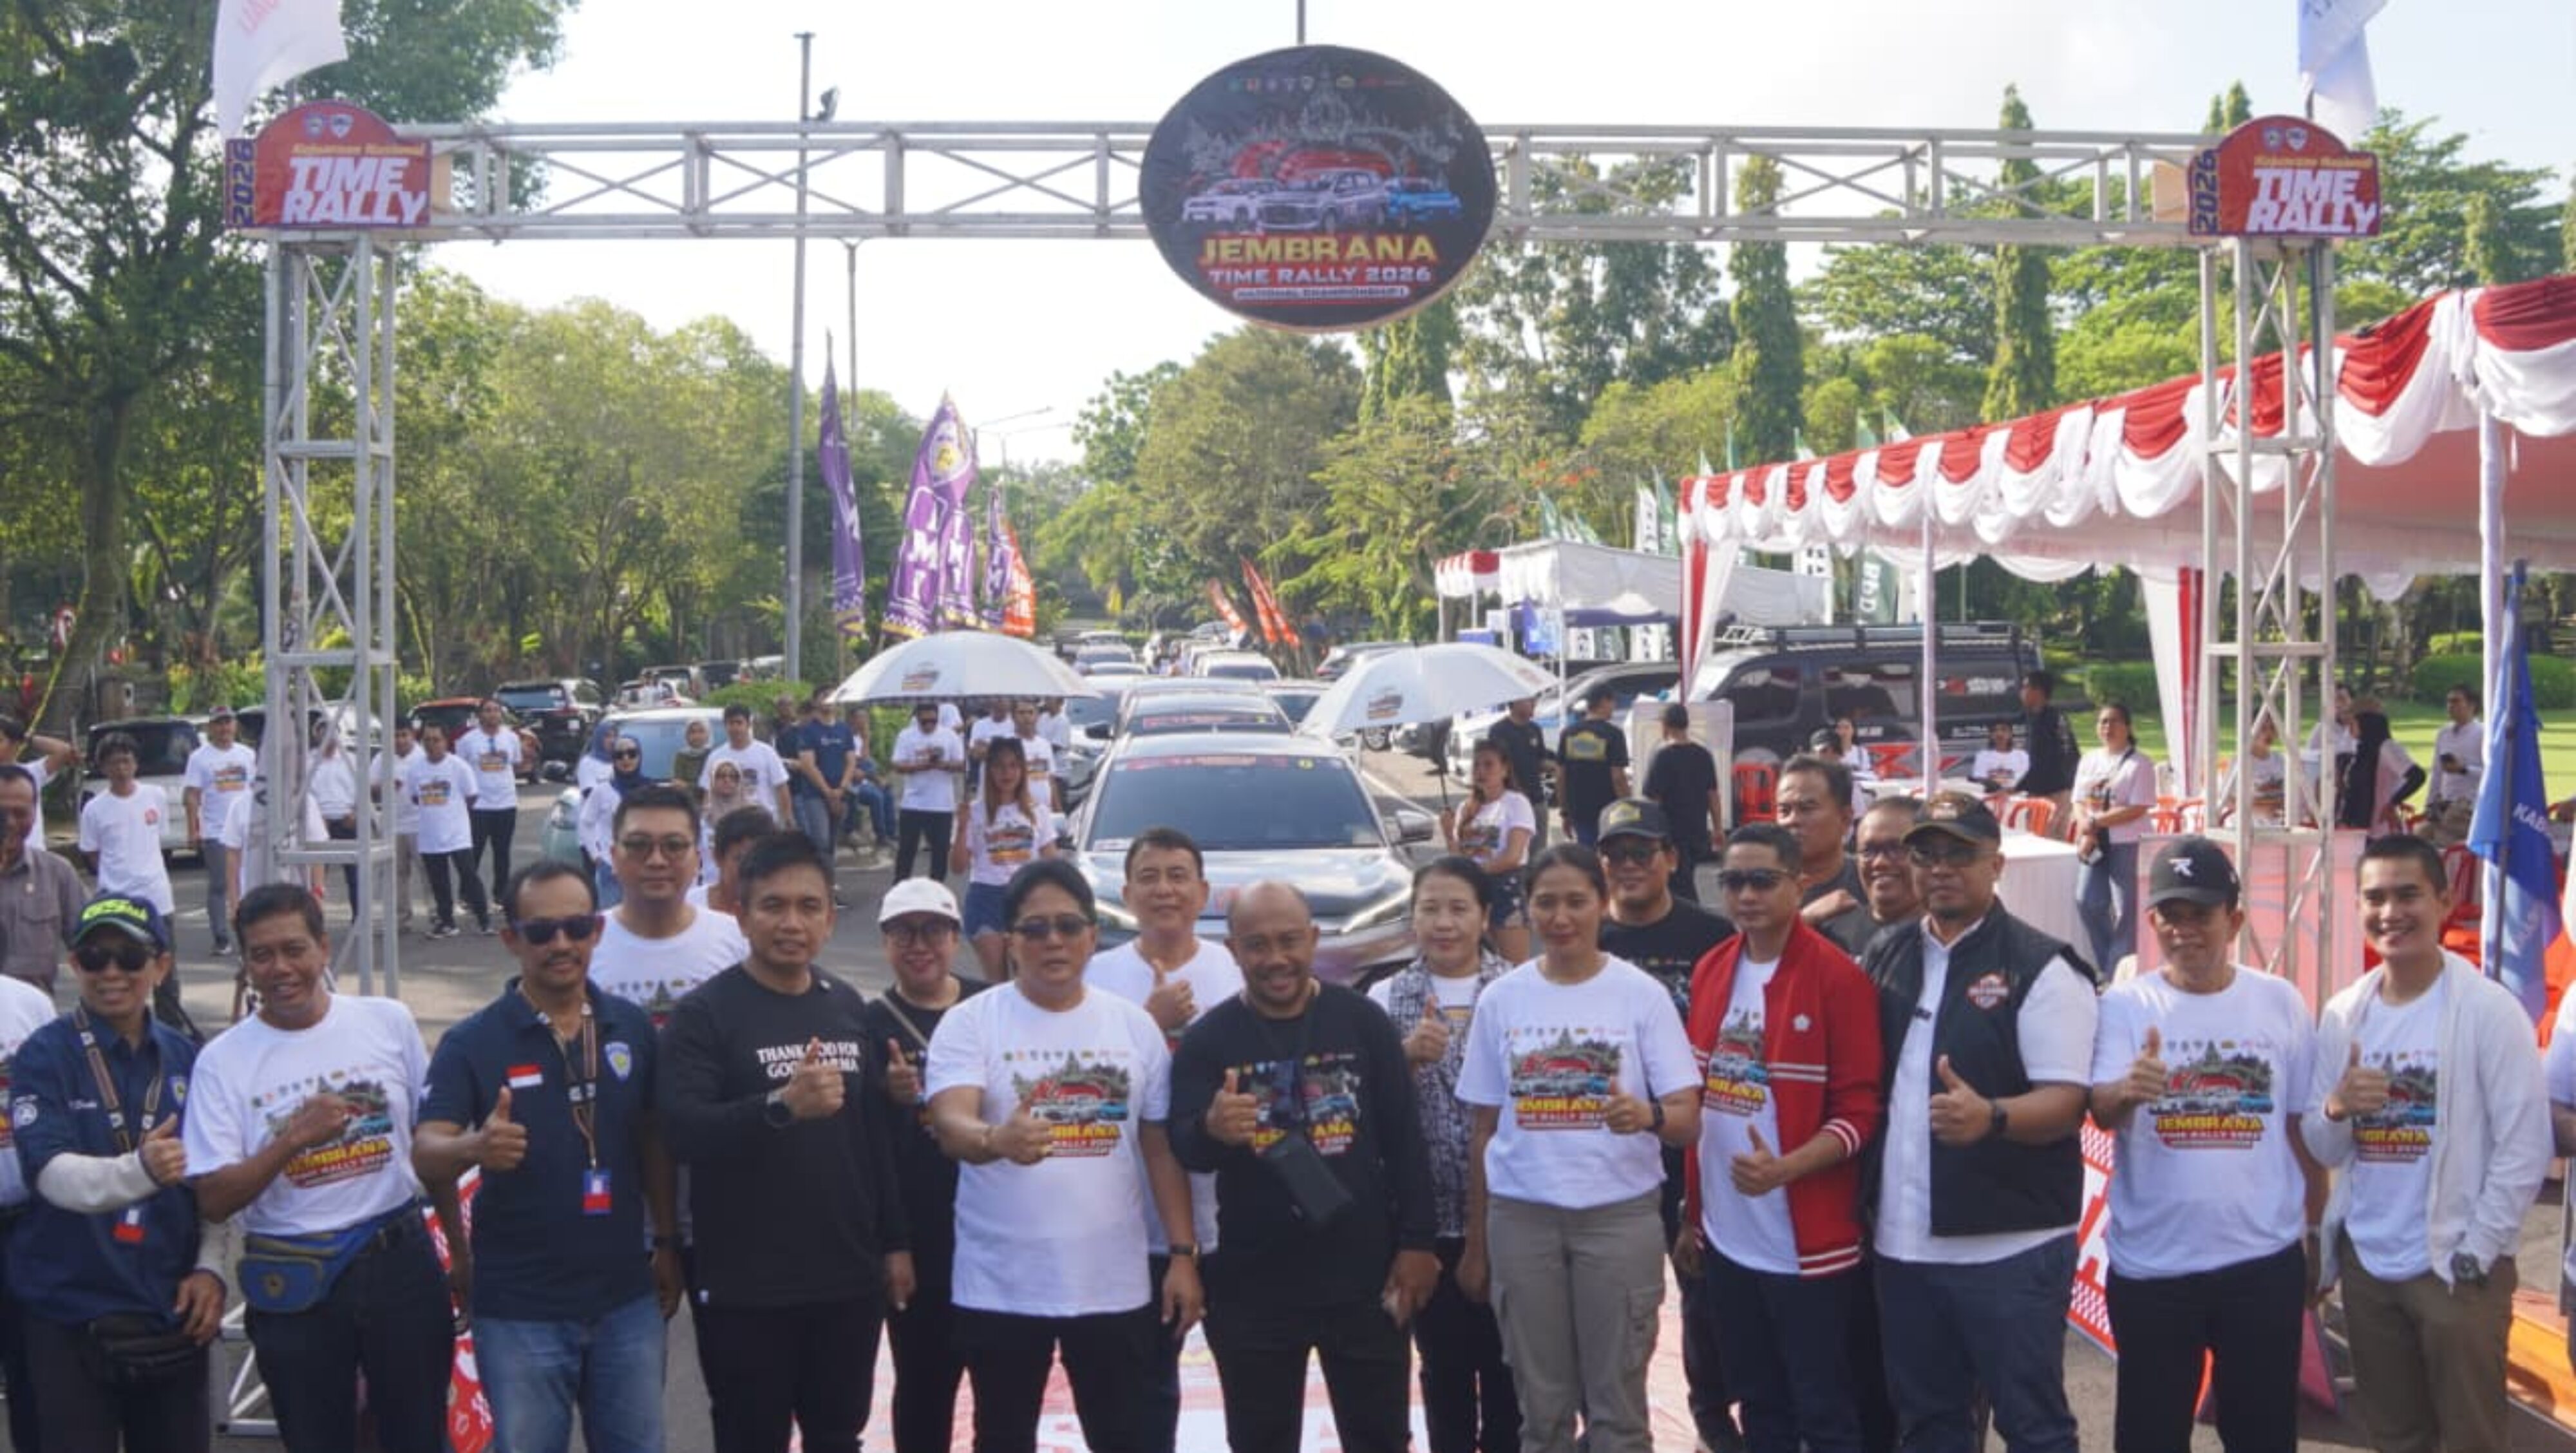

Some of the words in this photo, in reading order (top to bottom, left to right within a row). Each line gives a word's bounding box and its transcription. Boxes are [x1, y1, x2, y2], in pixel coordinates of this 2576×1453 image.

[232, 144, 254, 225] 2026
[289, 157, 409, 193] TIME
[2195, 150, 2217, 233] 2026
[2253, 168, 2360, 202] TIME
[282, 191, 426, 224] RALLY
[2246, 197, 2378, 234] RALLY
[1202, 234, 1437, 265] JEMBRANA
[1209, 268, 1270, 285] TIME
[1278, 266, 1357, 283] RALLY
[1365, 266, 1432, 283] 2026
[756, 1043, 804, 1064] THANK
[2158, 1115, 2263, 1130] JEMBRANA
